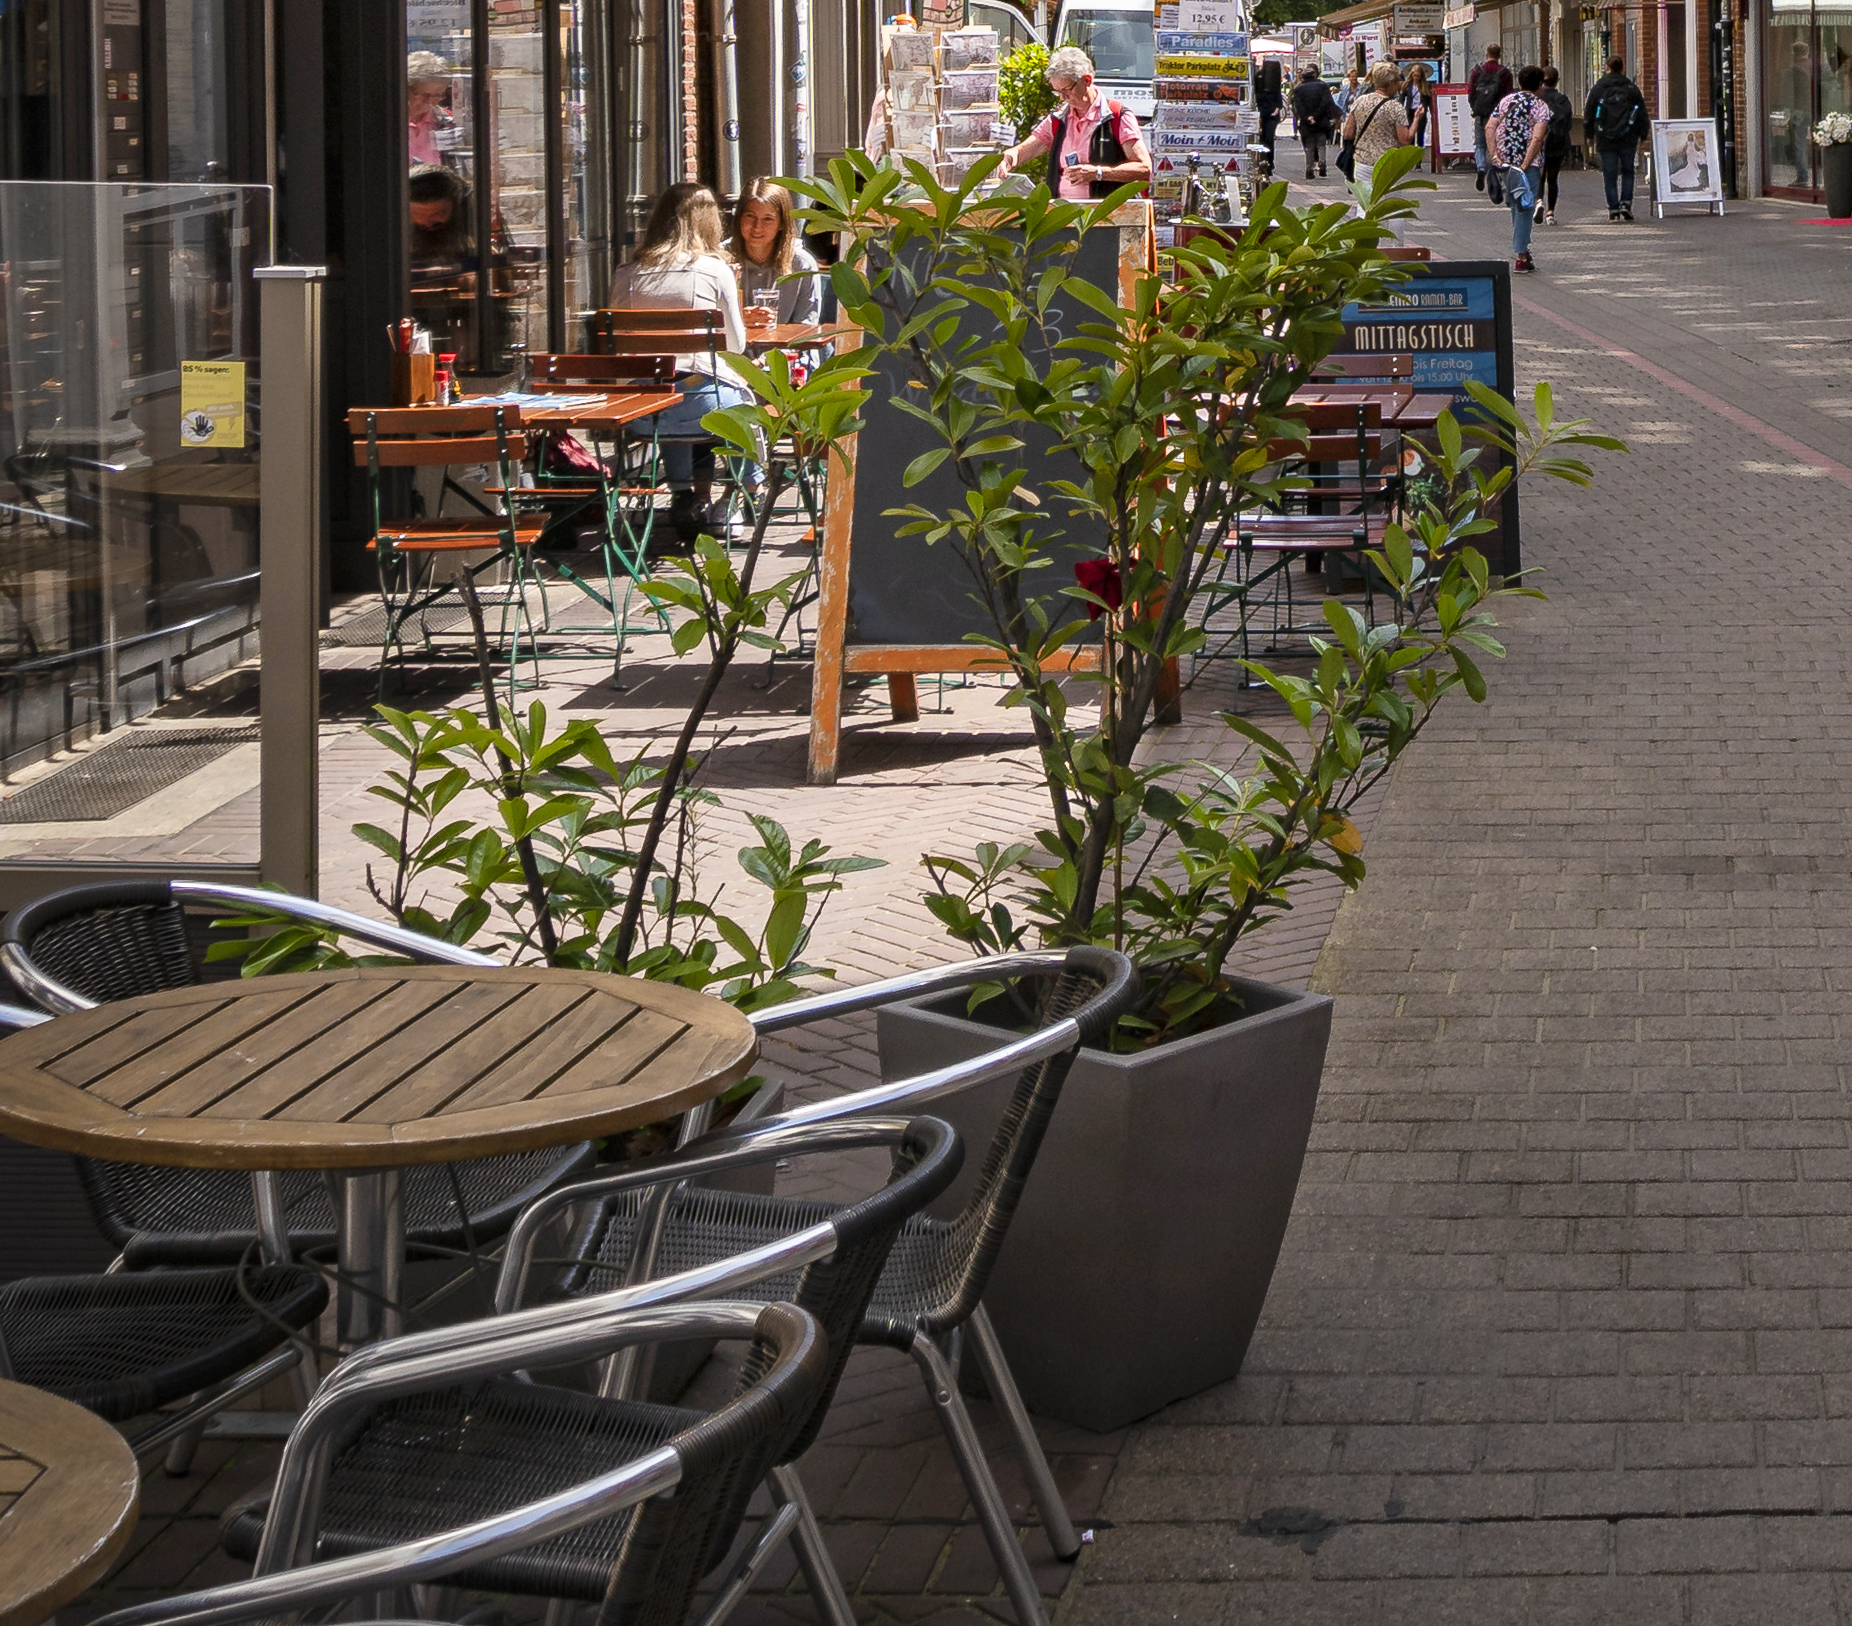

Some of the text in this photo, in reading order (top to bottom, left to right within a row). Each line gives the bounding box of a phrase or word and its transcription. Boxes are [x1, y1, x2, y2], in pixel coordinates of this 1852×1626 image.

[1171, 35, 1233, 49] Paradies
[1158, 61, 1221, 72] Traktor Parkplatz
[1161, 133, 1194, 146] Moin
[1207, 135, 1240, 147] Moin
[1421, 293, 1463, 306] RAMEN-BAR
[1355, 324, 1474, 350] MITTAGSTISCH
[1430, 358, 1473, 370] Freitag
[1428, 371, 1452, 382] 15:00
[1454, 371, 1474, 381] Uhr
